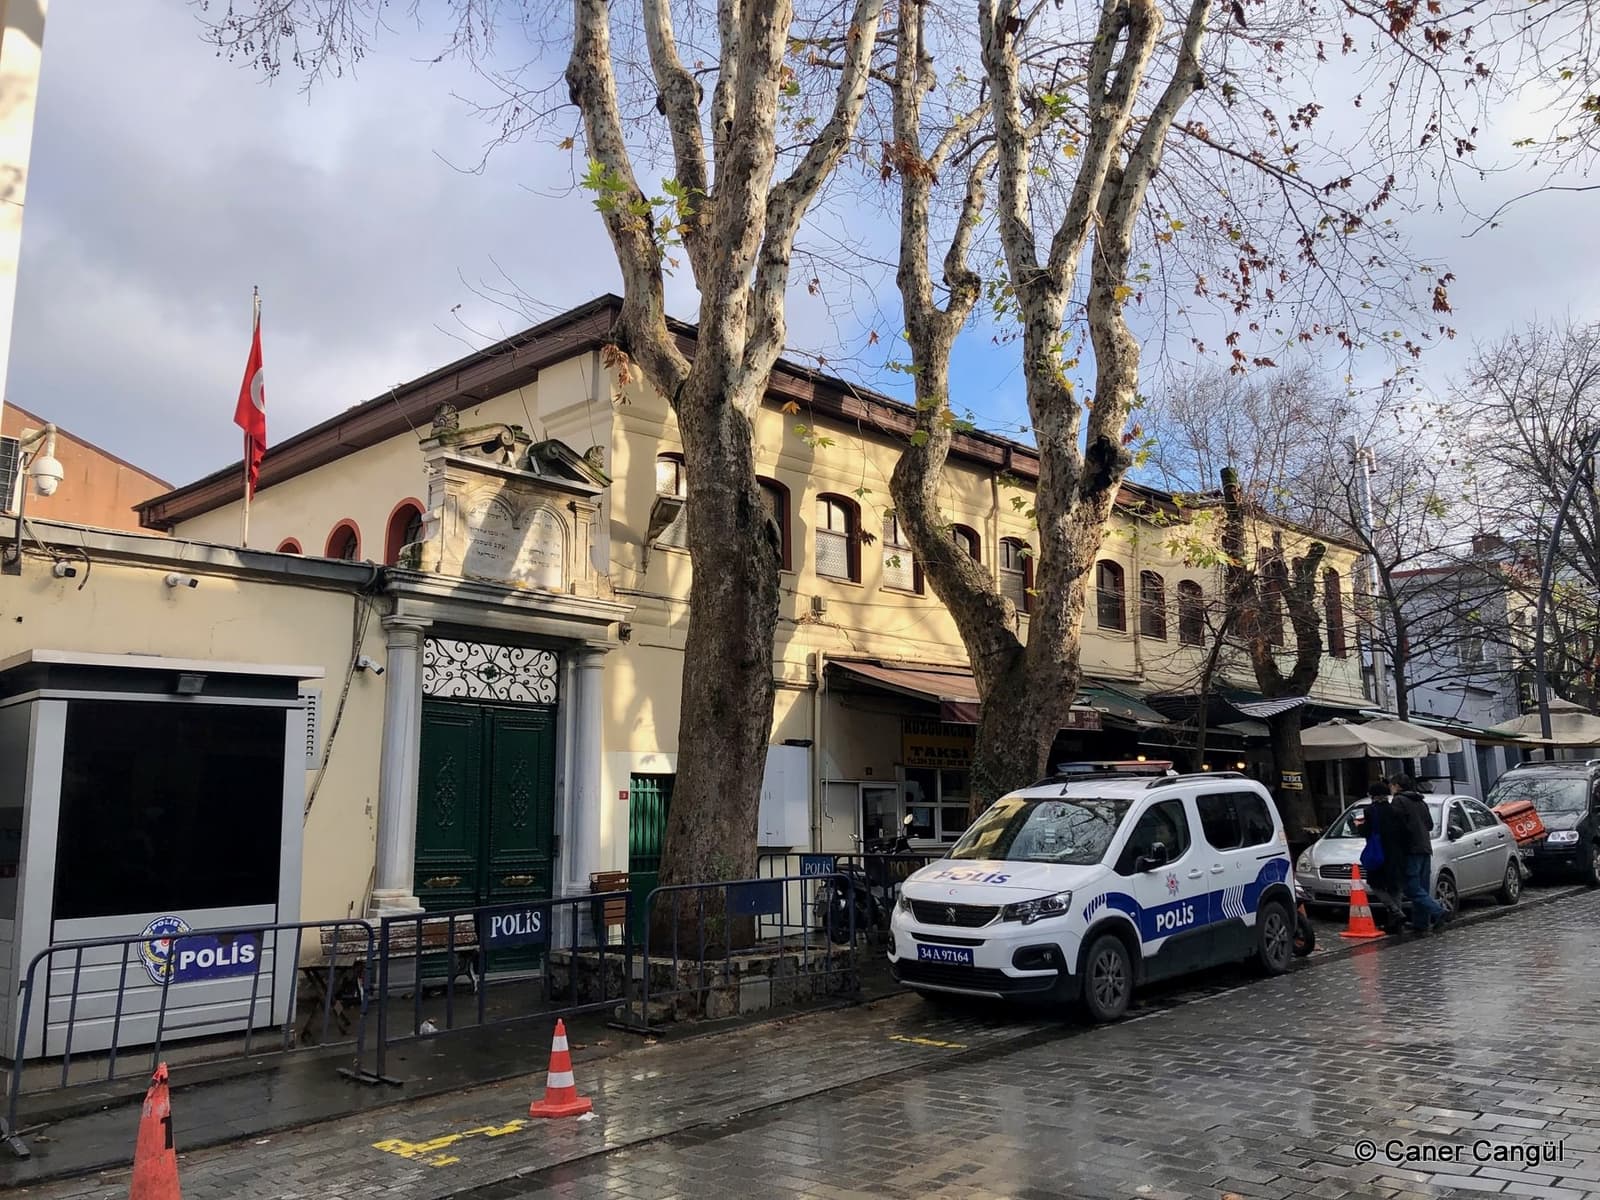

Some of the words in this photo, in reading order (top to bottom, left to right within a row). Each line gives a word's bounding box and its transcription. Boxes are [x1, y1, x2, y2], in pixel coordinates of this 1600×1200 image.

[934, 870, 1012, 884] POLİS
[490, 909, 541, 938] POLİS
[1156, 901, 1194, 933] POLİS
[179, 941, 255, 970] POLİS
[920, 947, 931, 959] 34
[932, 948, 941, 960] A
[941, 950, 969, 962] 97164
